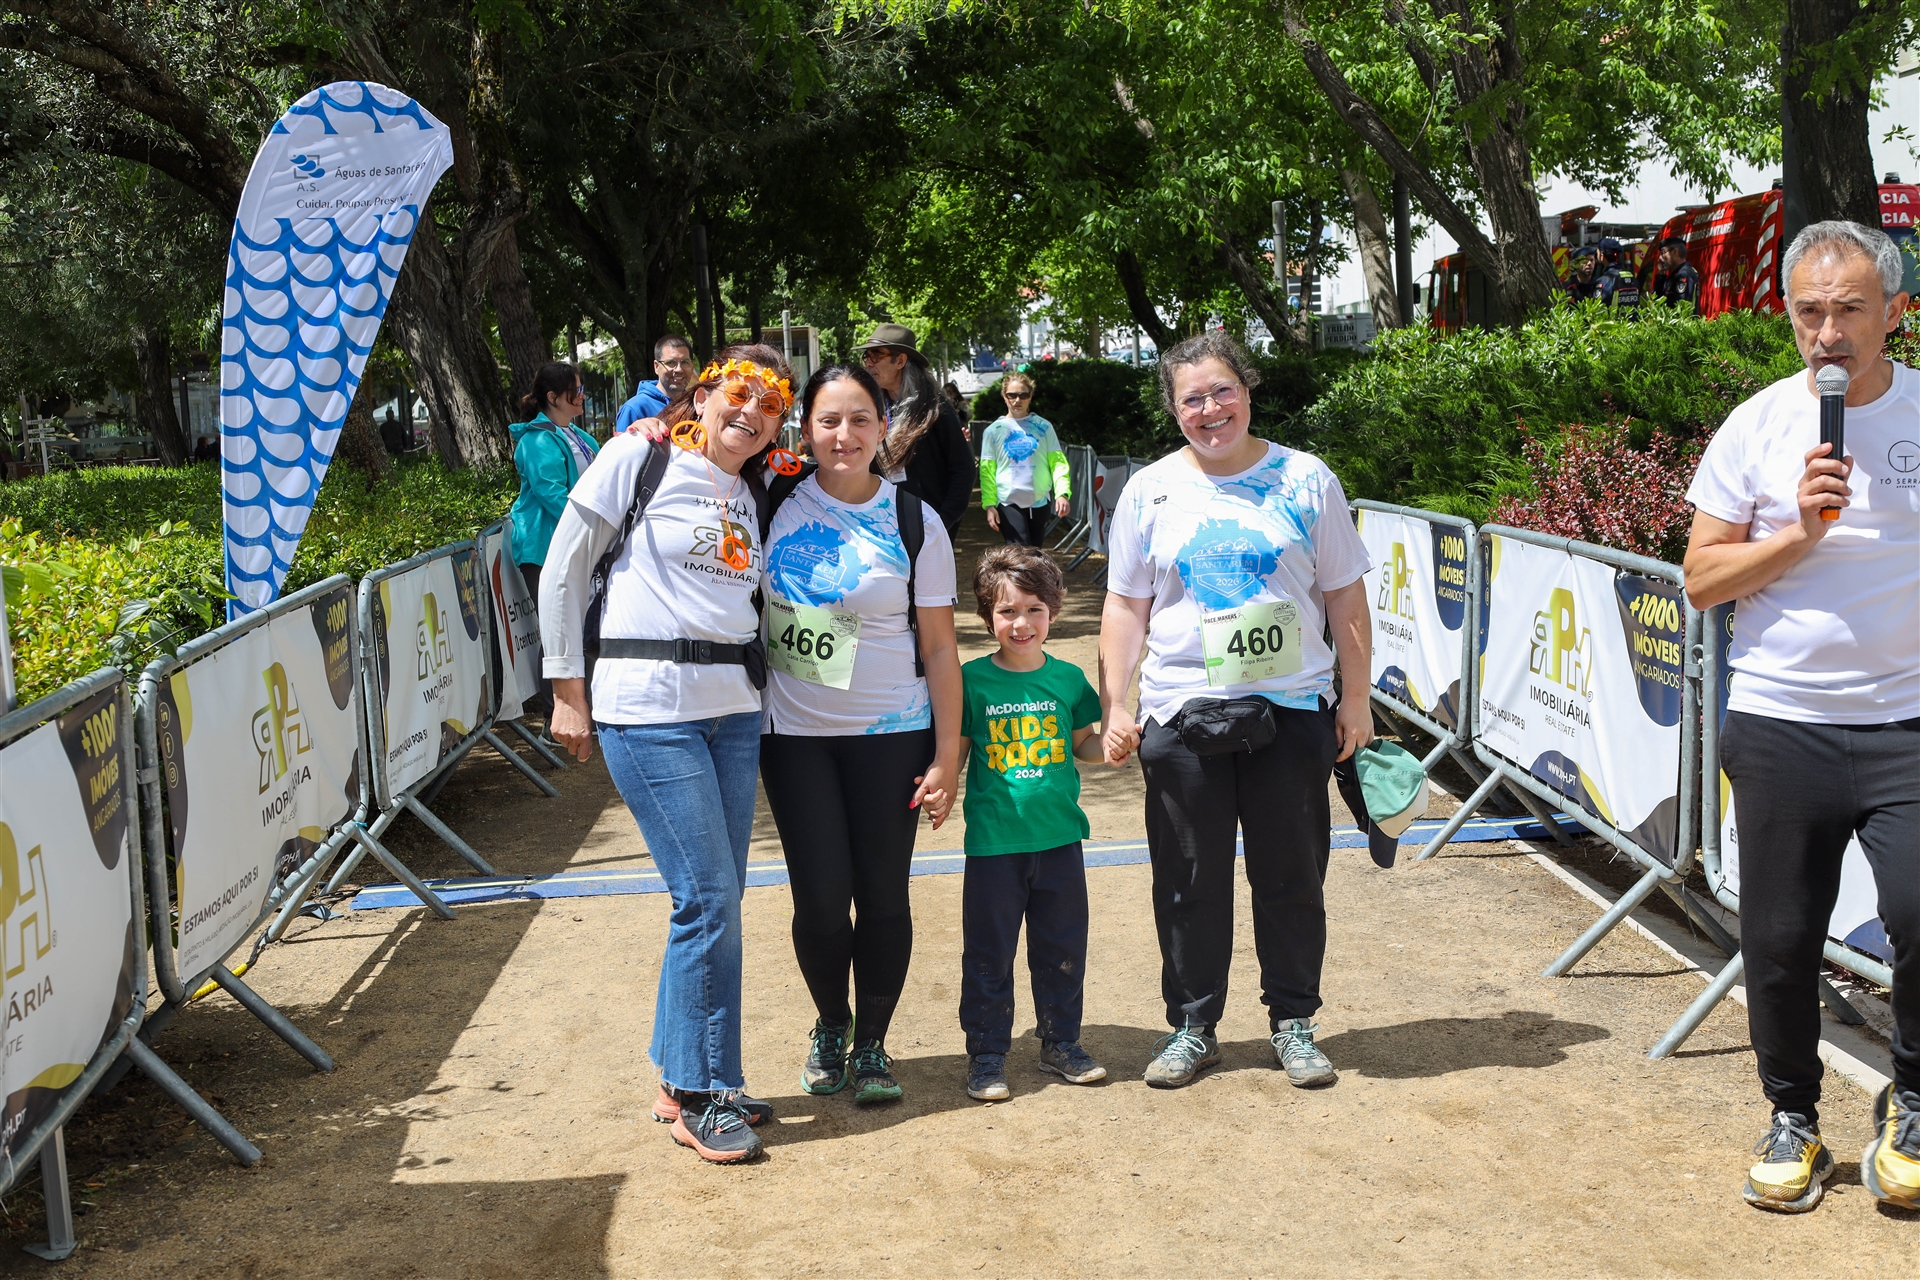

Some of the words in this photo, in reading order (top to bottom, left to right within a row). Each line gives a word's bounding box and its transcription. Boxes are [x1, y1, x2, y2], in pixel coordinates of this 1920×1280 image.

[335, 166, 366, 180] Águas
[369, 167, 381, 177] de
[296, 182, 320, 192] A.S.
[1880, 193, 1911, 204] CIA
[296, 198, 333, 208] Cuidar.
[335, 199, 372, 209] Poupar.
[1881, 212, 1911, 224] CIA
[1440, 535, 1464, 562] +1000
[784, 553, 838, 577] SANTARÉM
[795, 575, 818, 589] 2026
[1215, 577, 1240, 587] 2026
[1629, 593, 1680, 633] +1000
[780, 623, 835, 661] 466
[1226, 624, 1284, 658] 460
[1633, 630, 1680, 667] IMÓVEIS
[1240, 658, 1256, 666] Filipa
[1634, 660, 1680, 689] ANGARIADOS
[985, 700, 1056, 716] McDonald's
[1530, 685, 1591, 730] IMOBILIÁRIA
[988, 715, 1058, 743] KIDS
[985, 738, 1066, 774] RACE
[1015, 768, 1043, 779] 2024
[184, 896, 221, 936] ESTAMOS
[222, 879, 239, 908] AQUI
[239, 870, 253, 893] POR
[252, 865, 259, 882] SI
[6, 974, 54, 1030] ÁRIA
